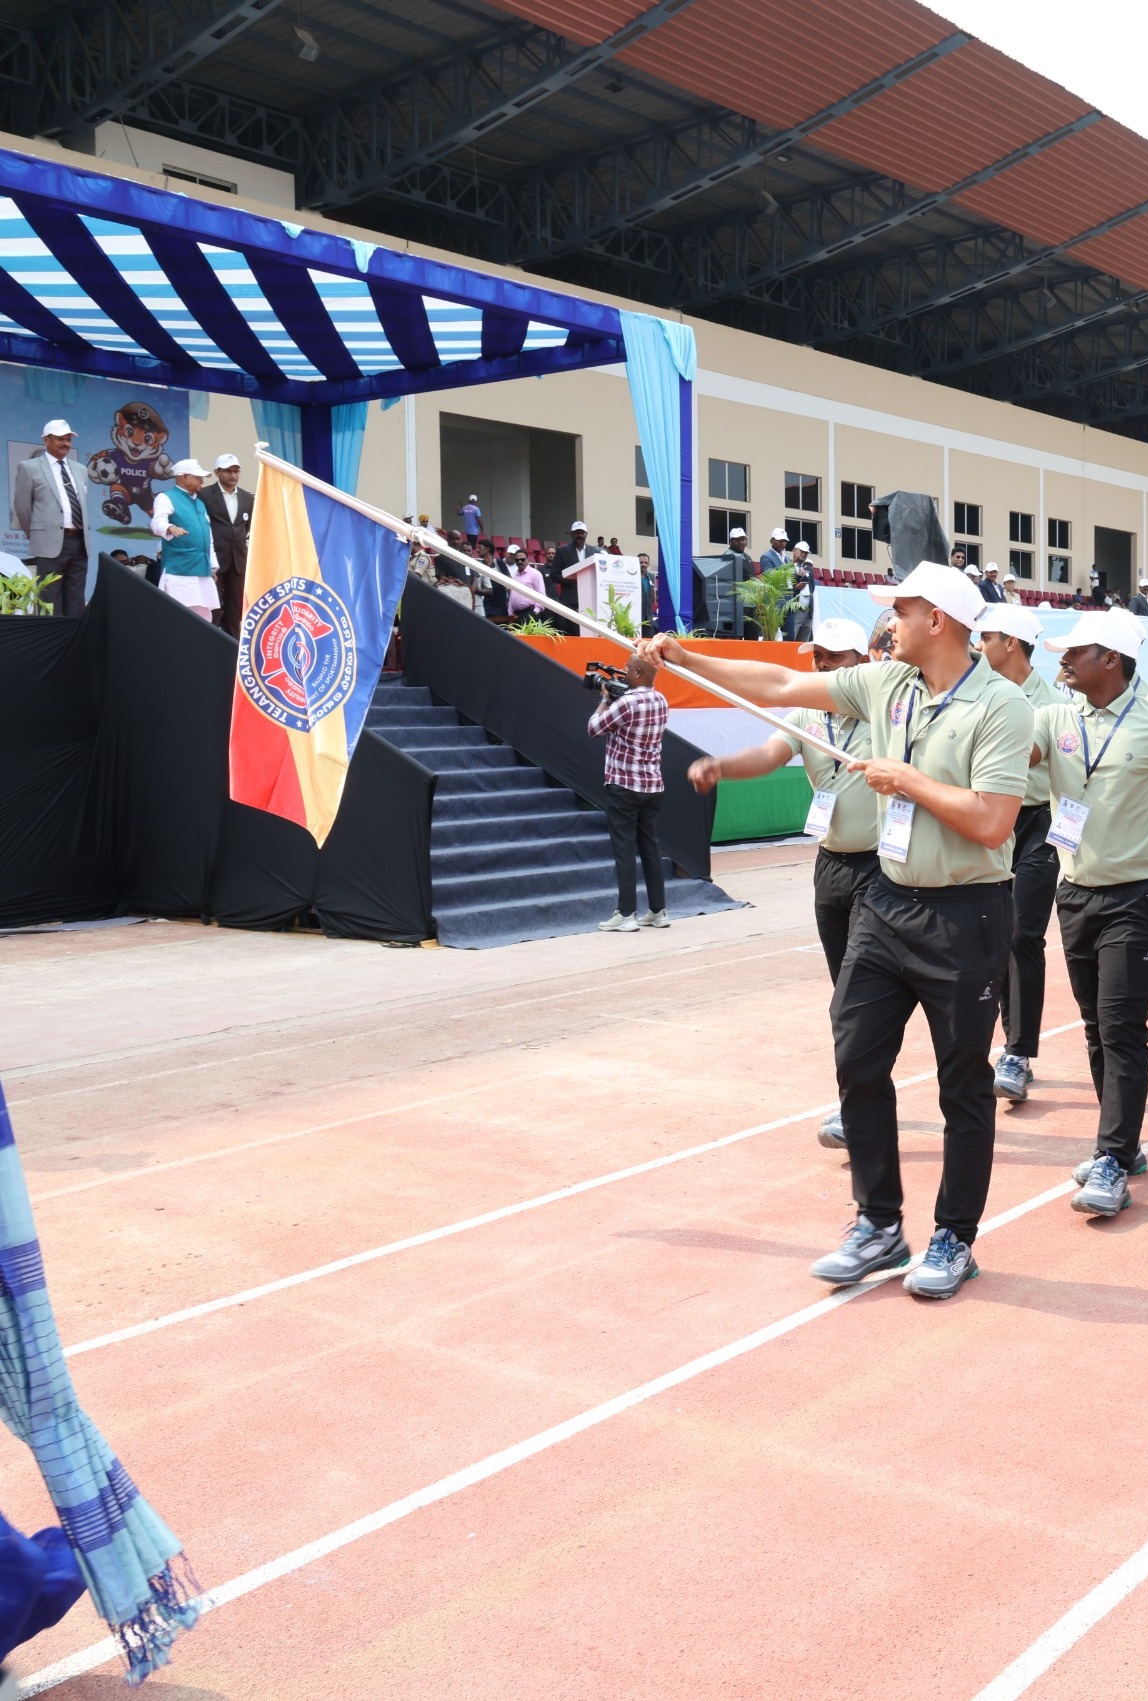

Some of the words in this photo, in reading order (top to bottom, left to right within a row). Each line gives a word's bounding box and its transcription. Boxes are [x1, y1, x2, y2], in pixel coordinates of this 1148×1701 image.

[121, 467, 147, 477] POLICE
[243, 593, 276, 640] POLICE
[266, 620, 284, 659] INTEGRITY
[312, 662, 328, 688] RAISING
[323, 654, 331, 662] THE
[326, 638, 339, 684] SPORTSMANSHIP
[239, 644, 288, 723] TELANGANA
